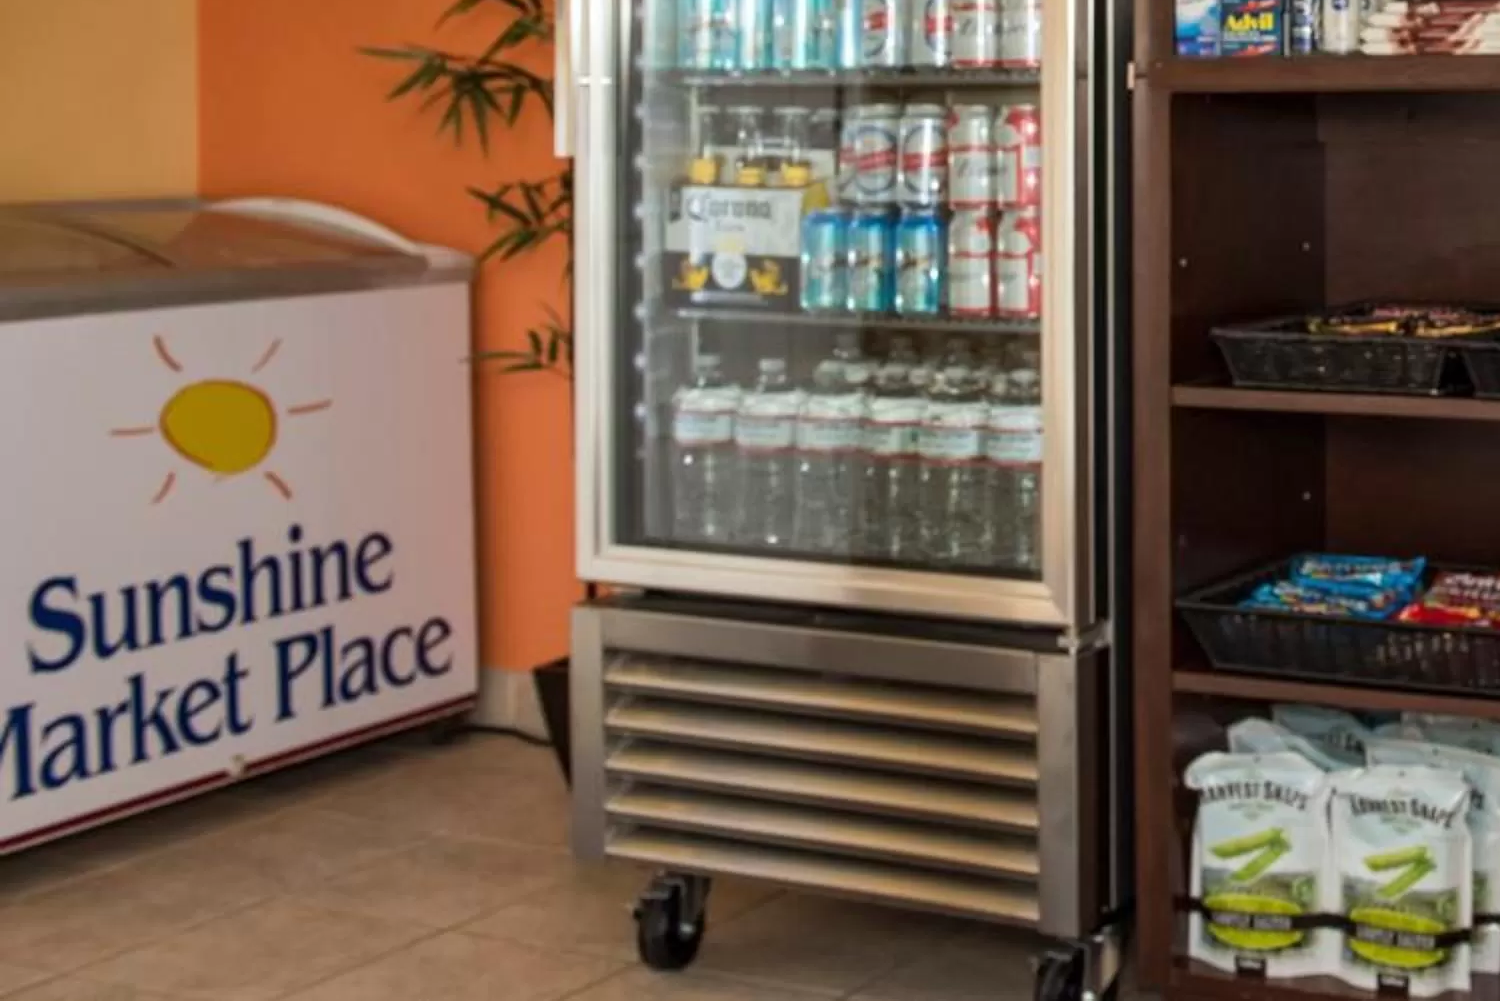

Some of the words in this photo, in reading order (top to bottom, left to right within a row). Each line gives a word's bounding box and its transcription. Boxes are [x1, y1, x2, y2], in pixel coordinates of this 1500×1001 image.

[1224, 11, 1275, 32] Advil
[26, 523, 395, 676] Sunshine
[272, 615, 454, 723] Place
